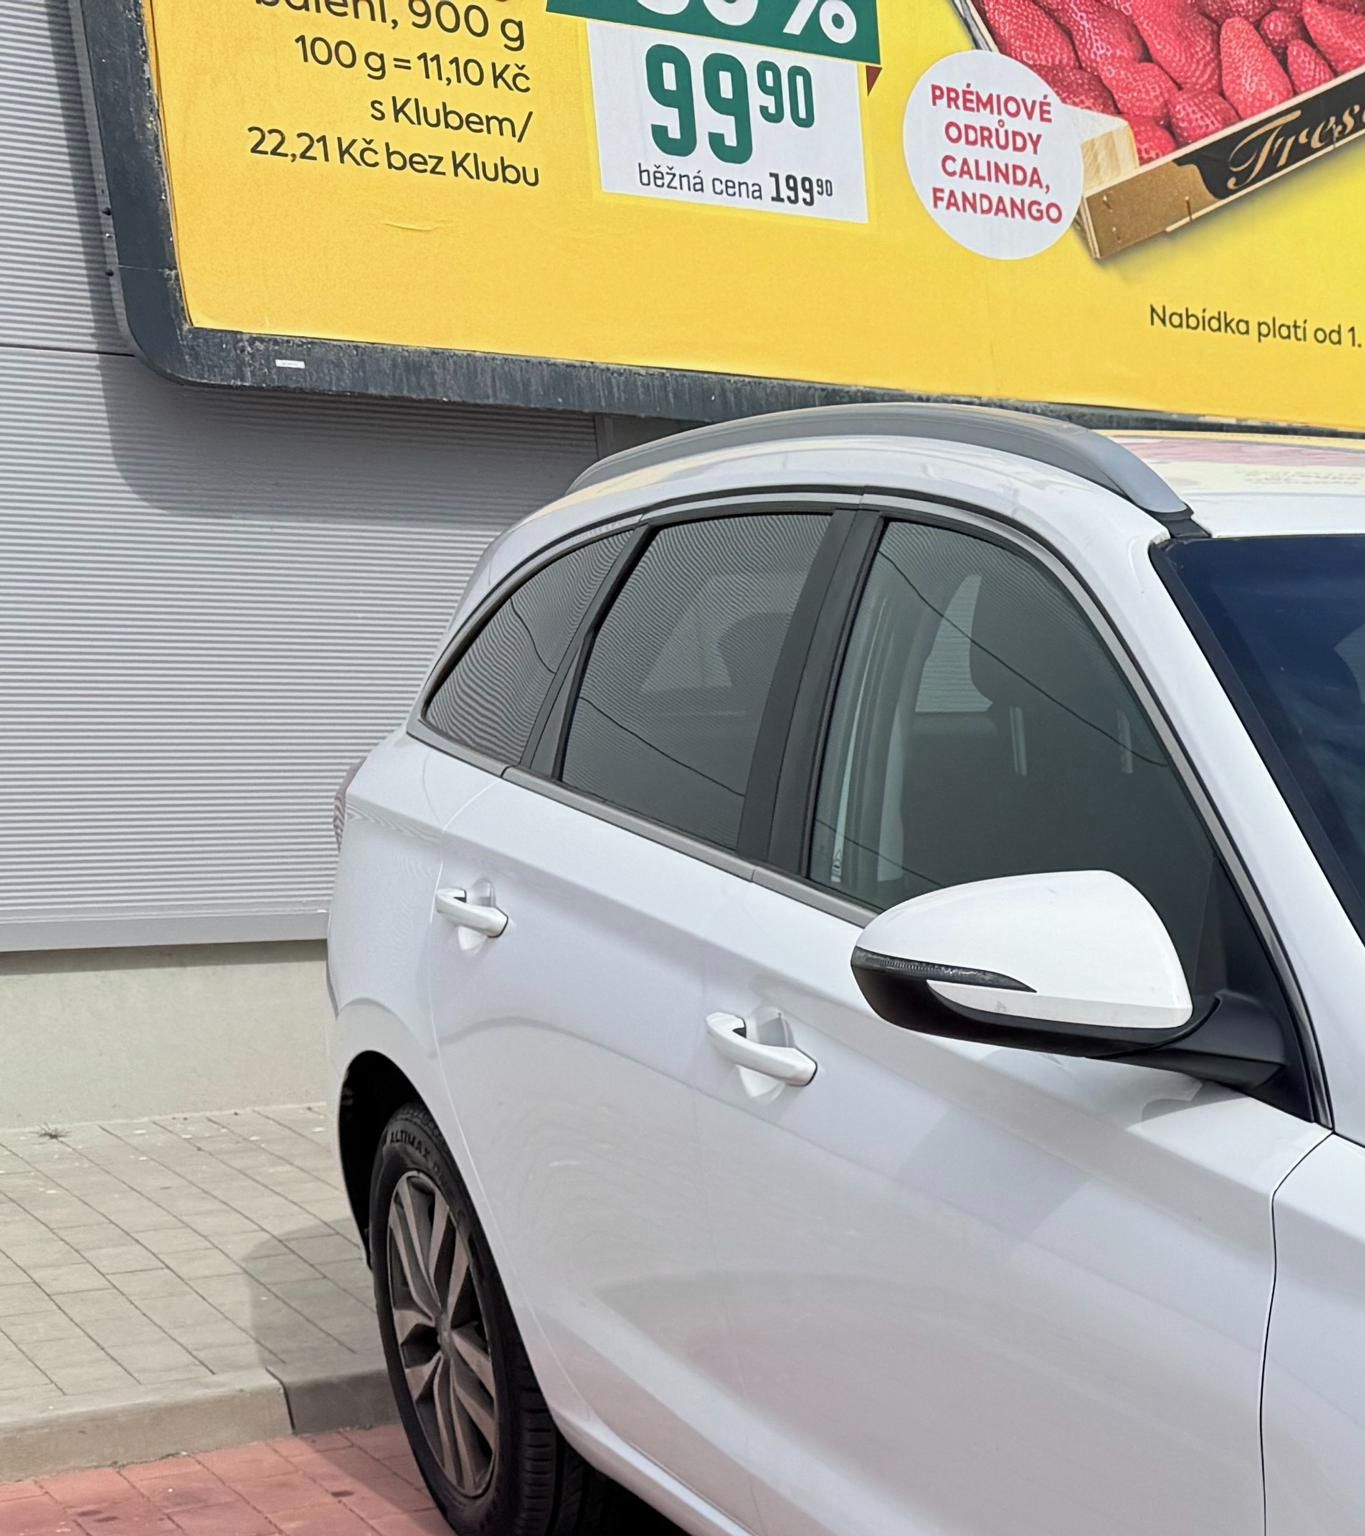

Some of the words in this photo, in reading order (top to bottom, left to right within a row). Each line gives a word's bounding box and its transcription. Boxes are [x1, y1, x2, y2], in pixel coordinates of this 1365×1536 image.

[409, 0, 488, 37] 900
[500, 18, 525, 51] g
[295, 34, 356, 68] 100
[364, 51, 386, 80] g
[417, 52, 484, 86] 11,10
[491, 62, 530, 92] Kč
[370, 100, 385, 120] s
[392, 96, 533, 143] Klubem/
[931, 83, 1053, 123] PRÉMIOVÉ
[248, 127, 329, 162] 22,21
[337, 137, 379, 168] Kč
[385, 142, 446, 176] bez
[452, 151, 540, 187] Klubu
[944, 119, 1042, 155] ODRŮDY
[638, 163, 704, 193] běžná
[712, 176, 762, 200] cena
[941, 155, 1050, 194] CALINDA,
[932, 187, 1062, 224] FANDANGO
[1150, 304, 1250, 336] Nabídka
[1258, 317, 1307, 342] platí
[1314, 324, 1341, 345] od
[1348, 327, 1362, 348] 1.
